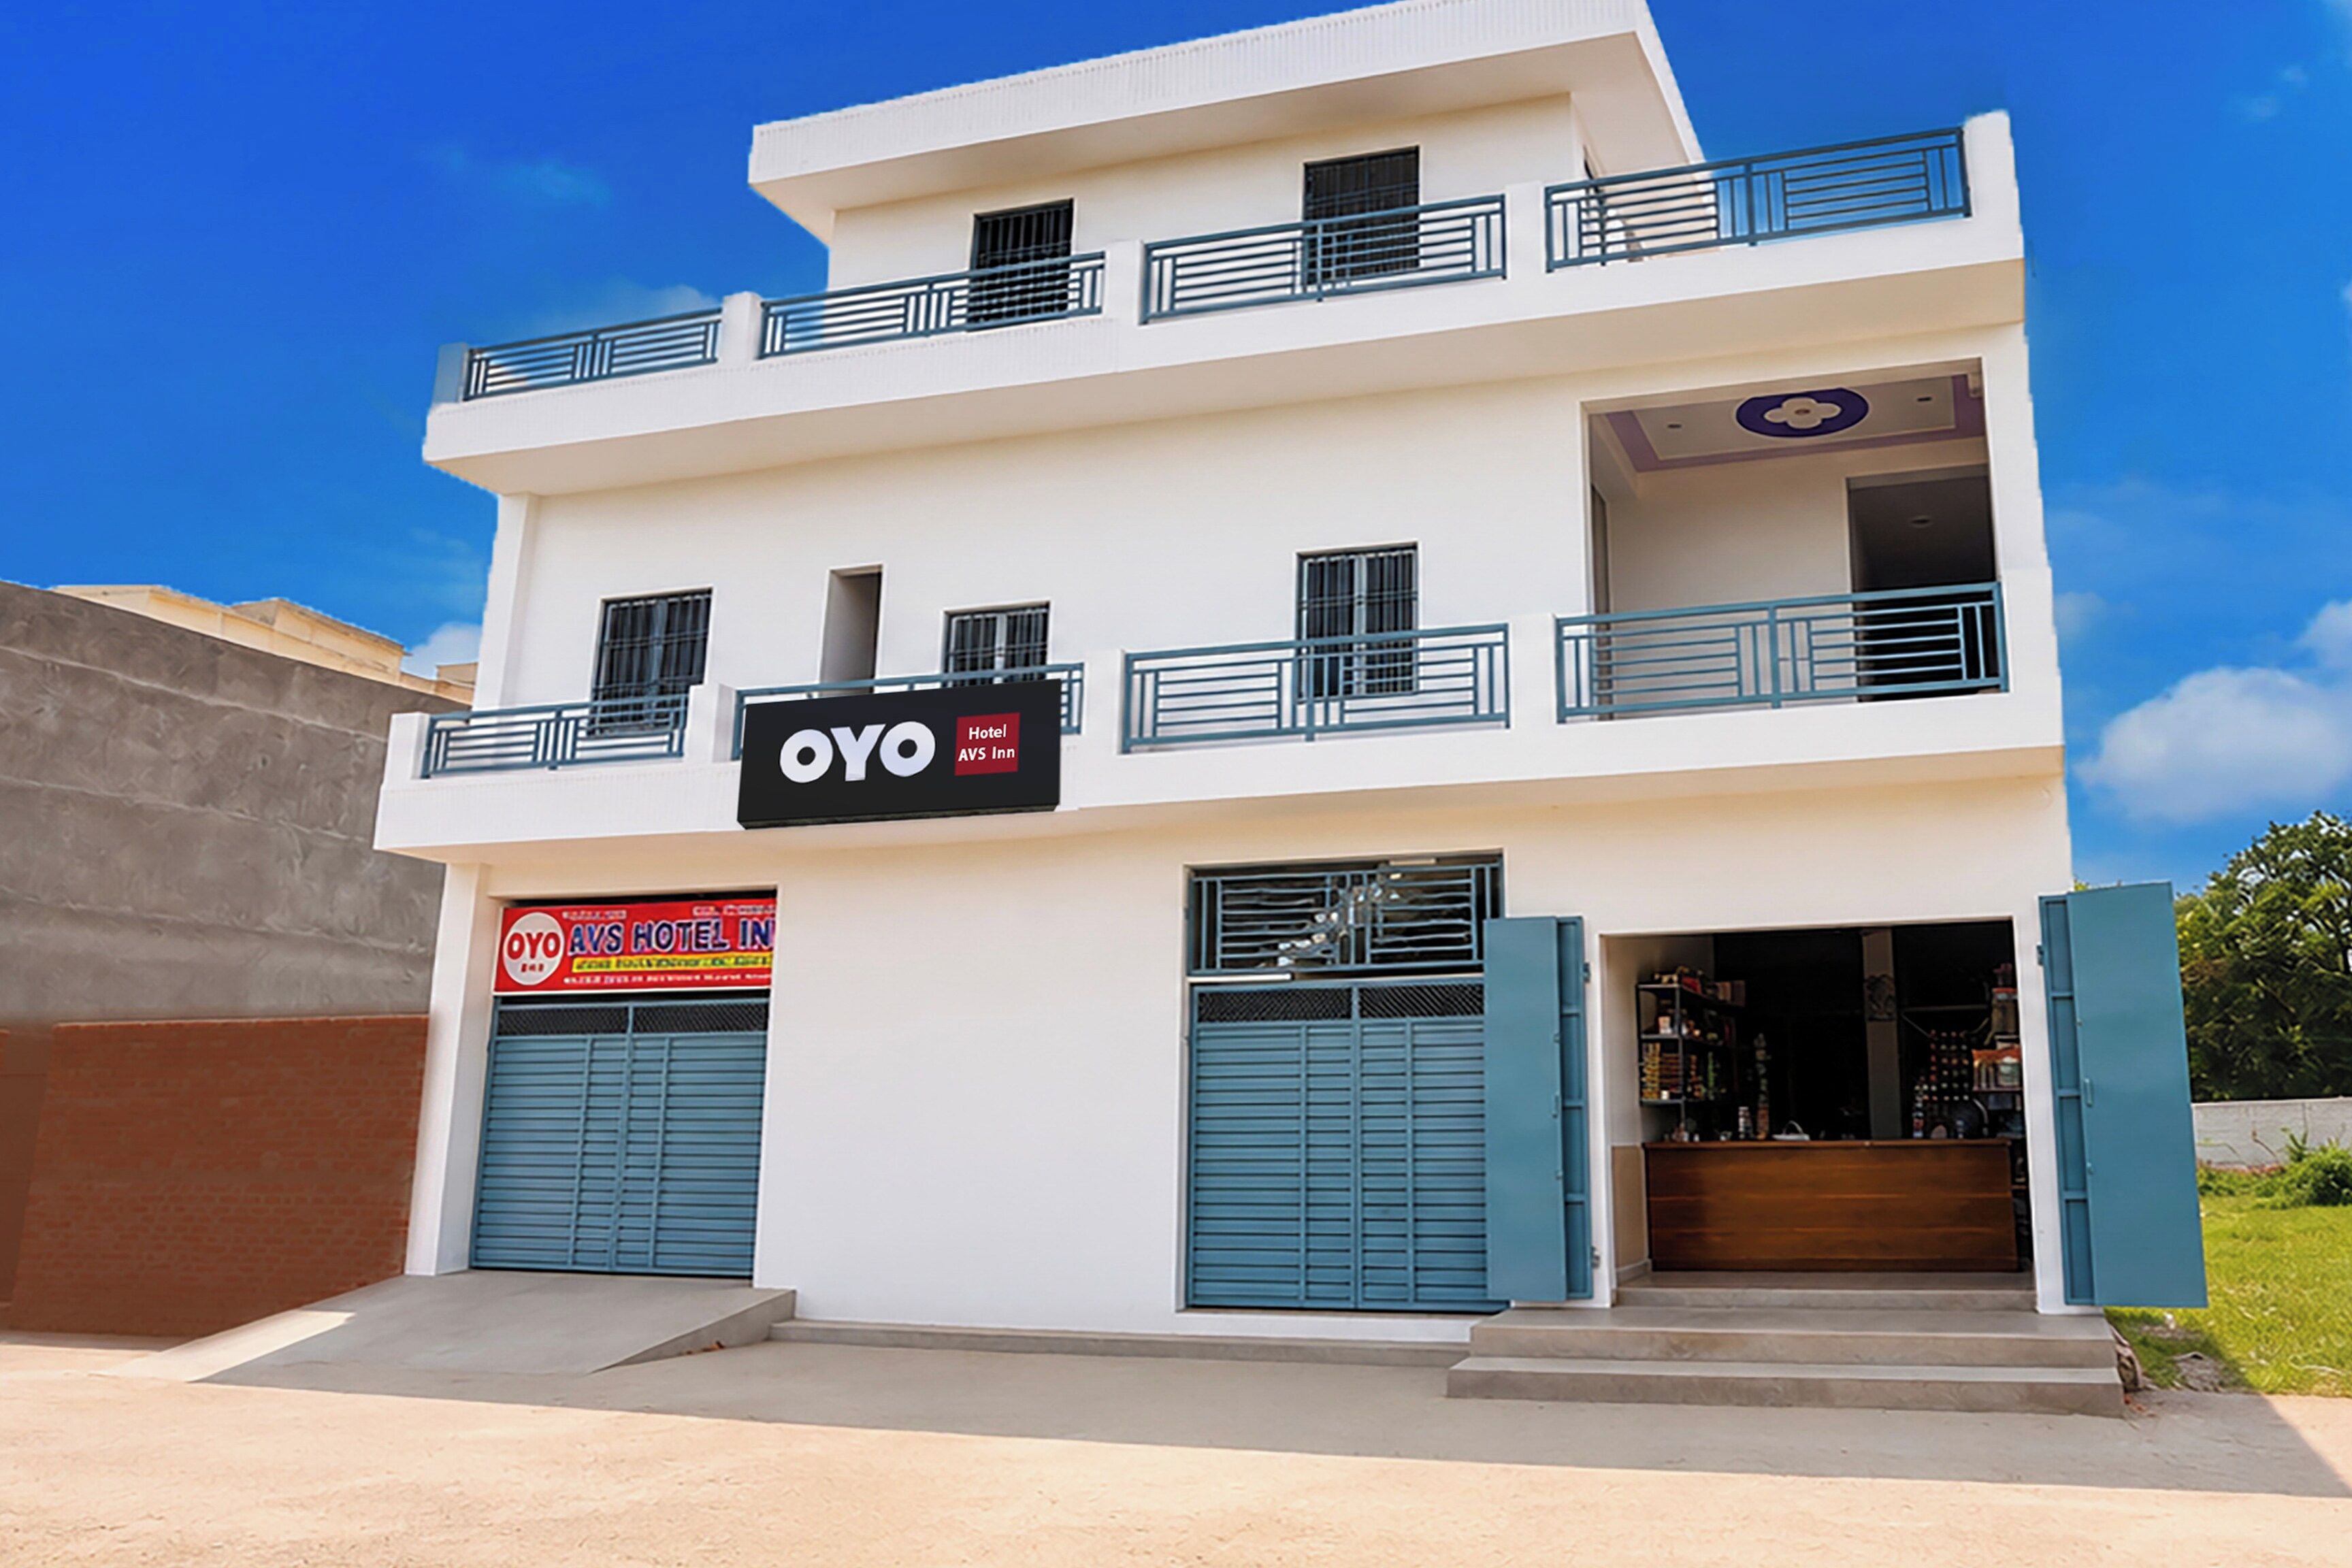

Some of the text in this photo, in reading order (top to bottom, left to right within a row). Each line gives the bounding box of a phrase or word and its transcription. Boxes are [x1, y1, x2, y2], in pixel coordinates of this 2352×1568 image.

[968, 723, 1007, 740] Hotel
[779, 721, 936, 783] OYO
[958, 746, 1015, 762] AVS Inn
[507, 932, 561, 960] OYO
[568, 921, 624, 956] AVS
[632, 916, 730, 952] HOTEL
